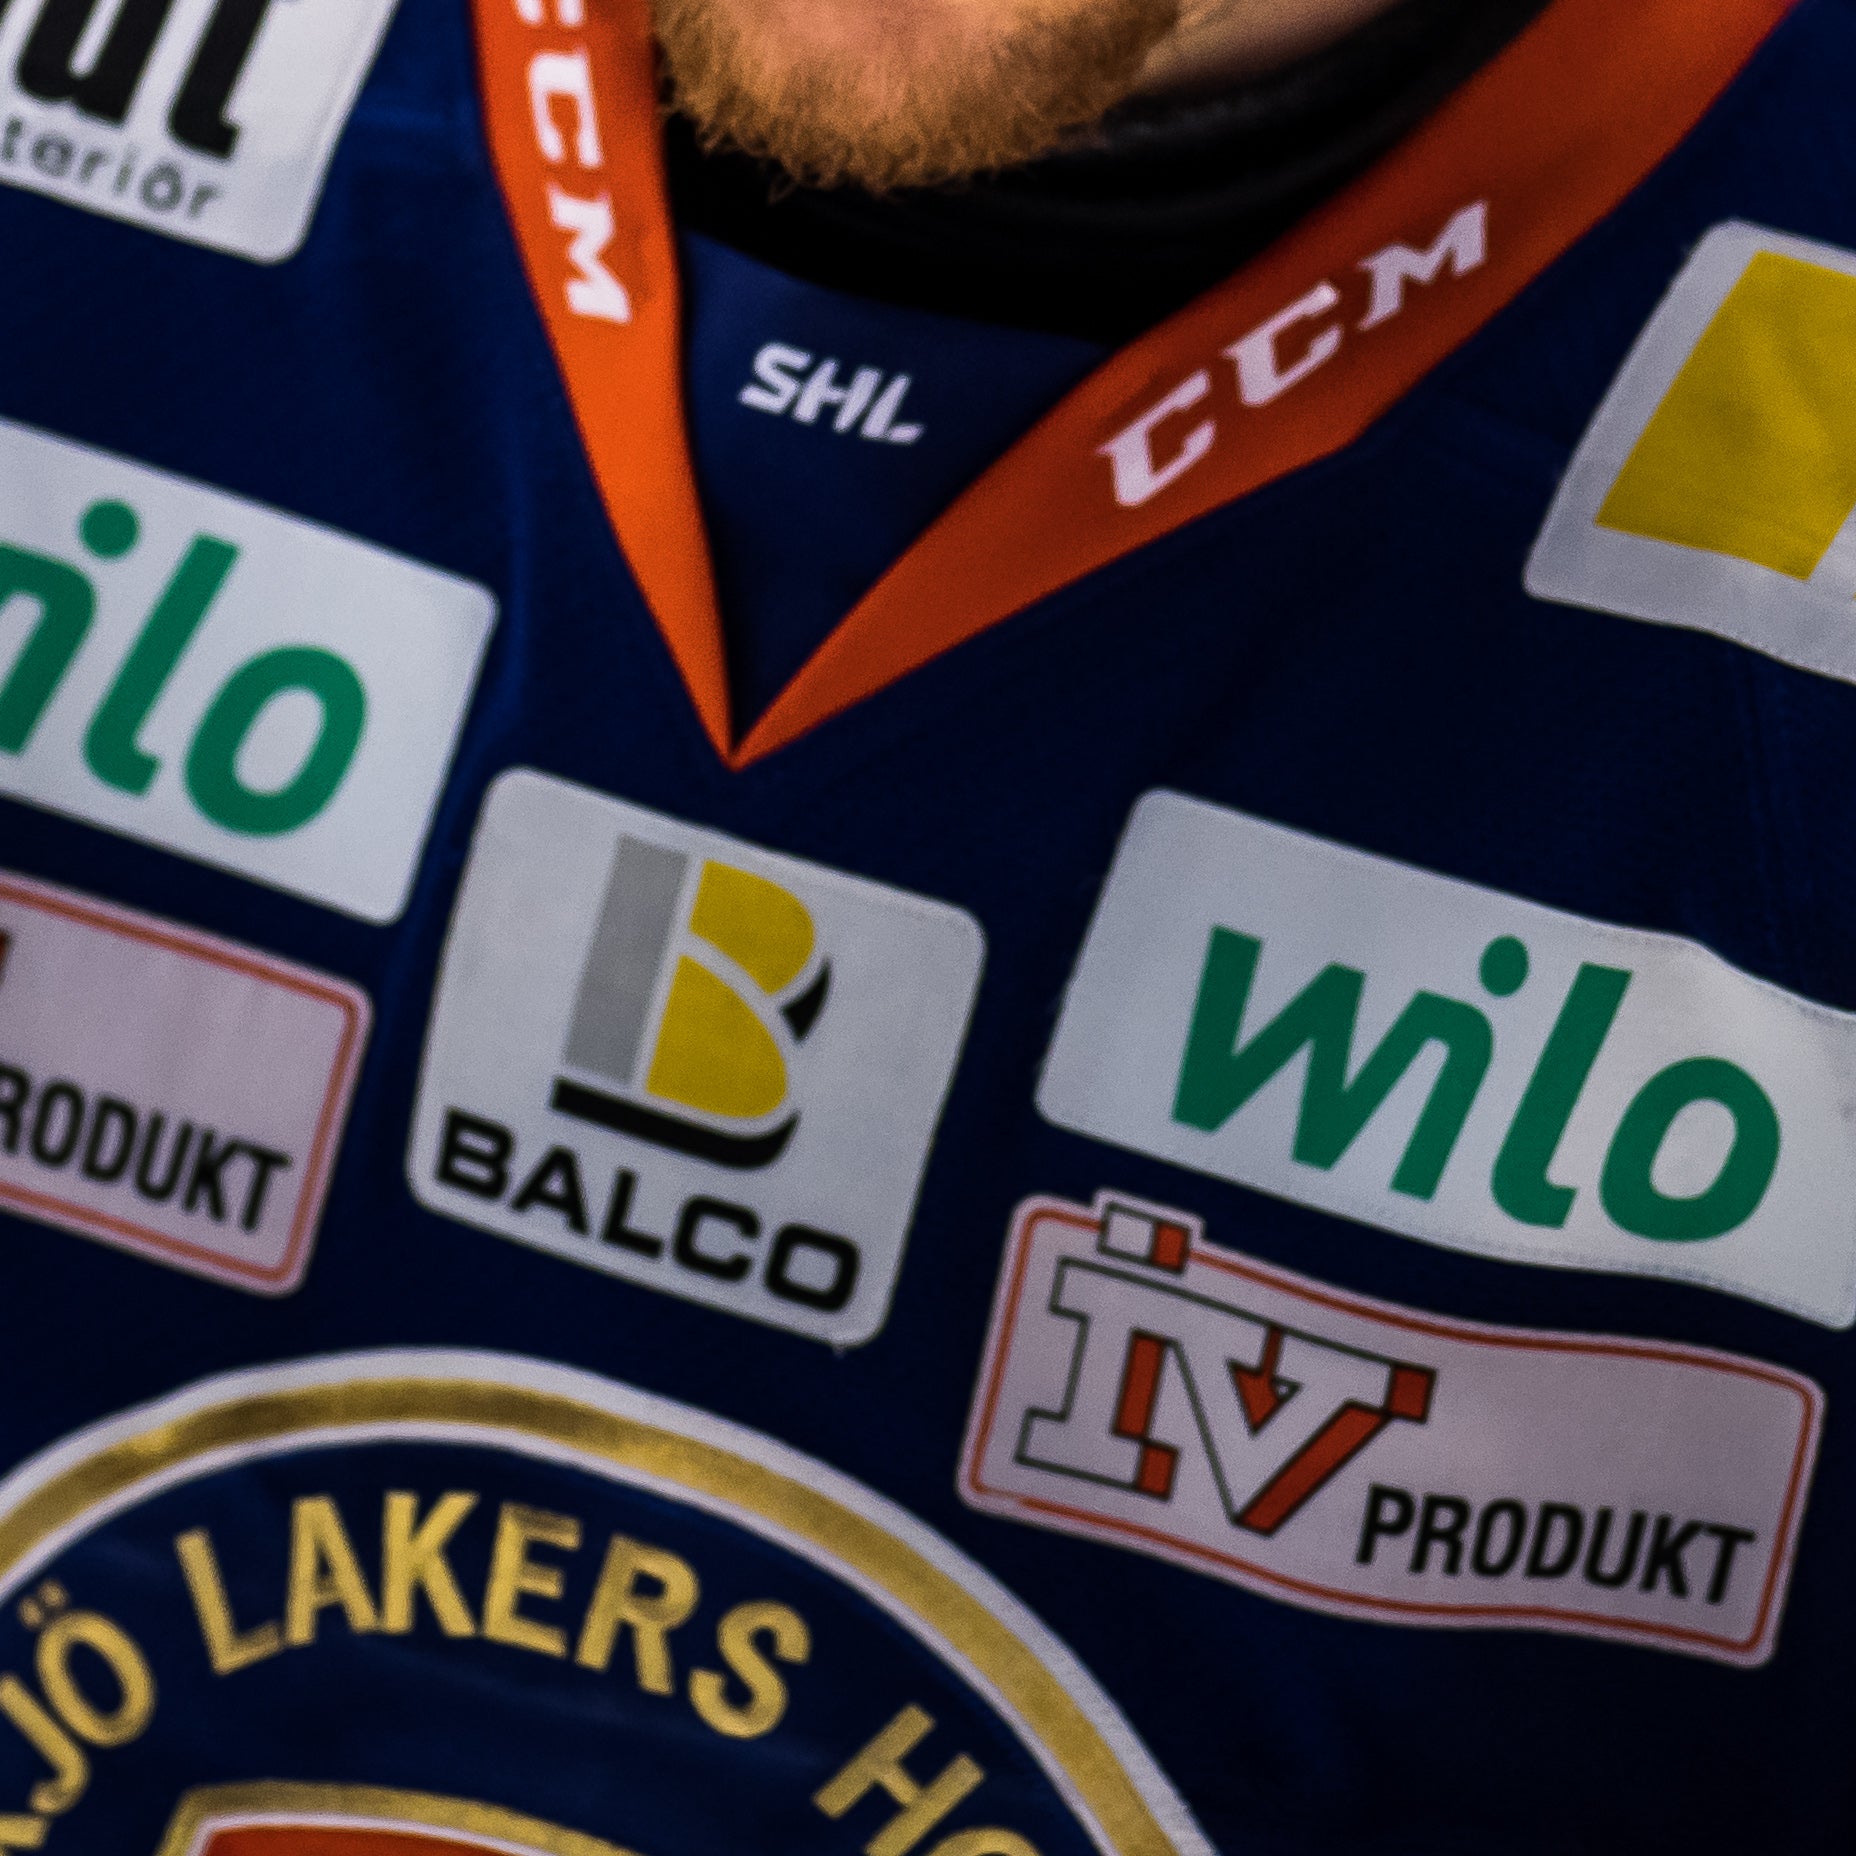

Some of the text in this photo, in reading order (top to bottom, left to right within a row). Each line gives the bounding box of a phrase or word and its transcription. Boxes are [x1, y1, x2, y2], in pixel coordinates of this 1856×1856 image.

[739, 342, 924, 444] SHL
[1097, 200, 1489, 507] CCM
[1170, 923, 1782, 1243] wilo
[433, 1106, 861, 1314] BALCO
[175, 1490, 812, 1739] LAKERS
[1355, 1481, 1756, 1608] PRODUKT
